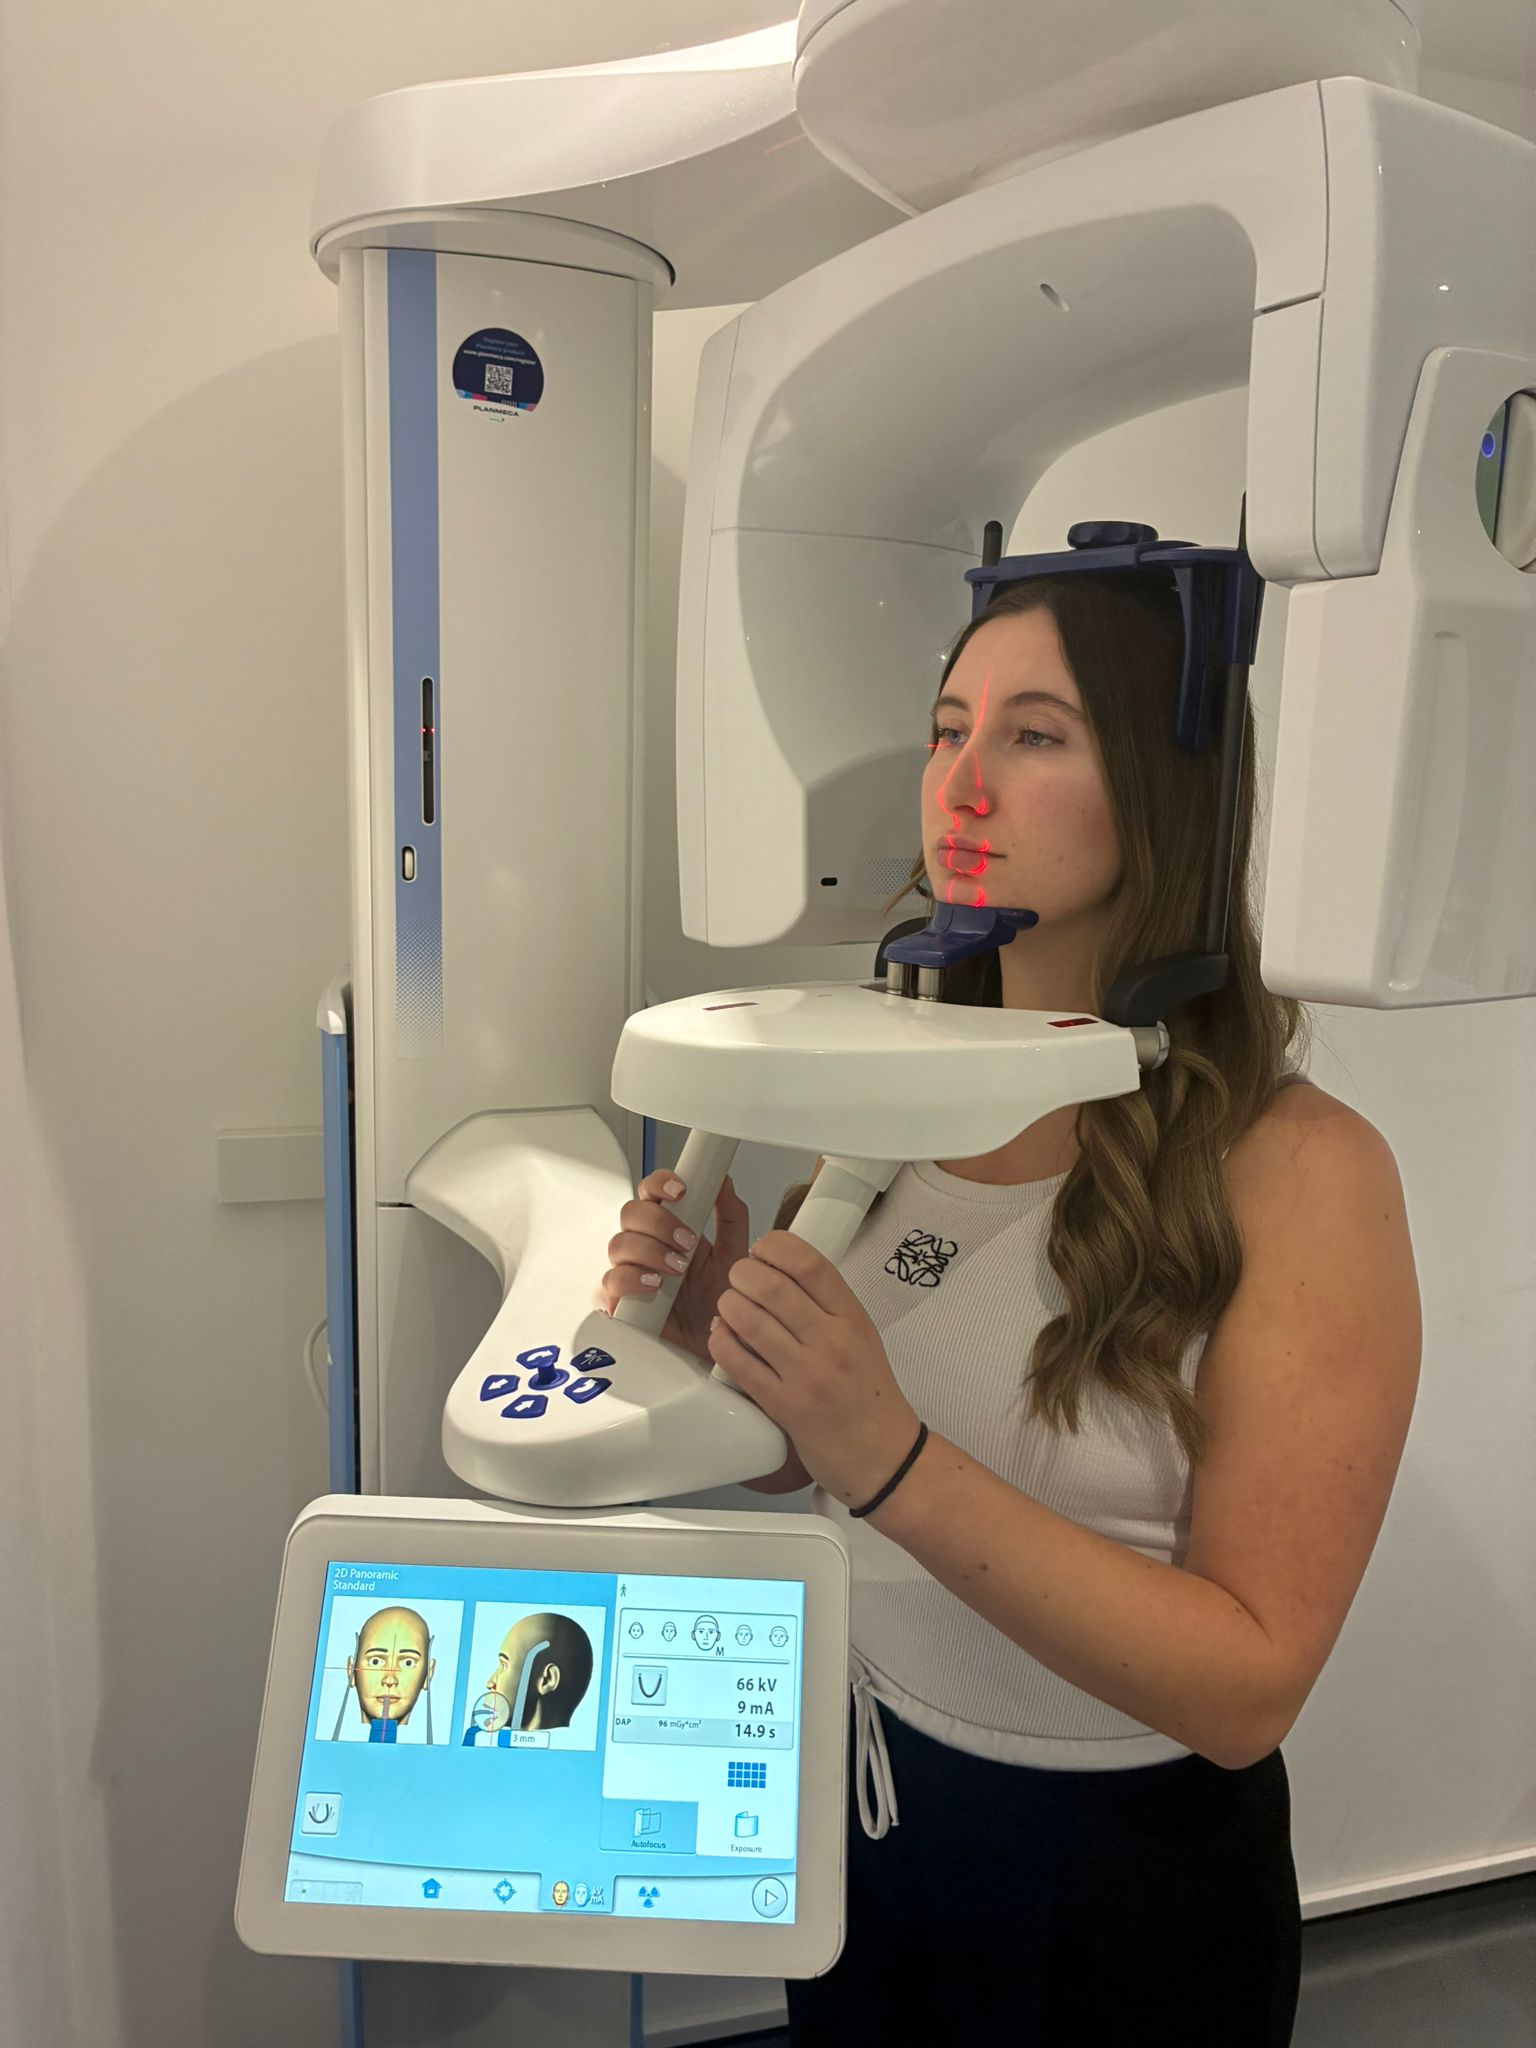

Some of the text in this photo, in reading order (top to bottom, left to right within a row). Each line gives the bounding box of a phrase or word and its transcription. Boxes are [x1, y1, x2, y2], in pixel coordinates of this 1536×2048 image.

[473, 405, 519, 417] PLANMECA
[334, 1568, 399, 1580] 2D Panoramic
[333, 1580, 375, 1591] Standard
[715, 1647, 725, 1656] M
[736, 1677, 777, 1692] 66 kV
[737, 1700, 774, 1715] 9 mA
[615, 1717, 632, 1726] DAP
[658, 1719, 668, 1727] 96
[735, 1723, 776, 1739] 14.9 s
[513, 1734, 535, 1743] 3 mm
[631, 1840, 666, 1849] Autofocus
[730, 1844, 762, 1853] Exposure
